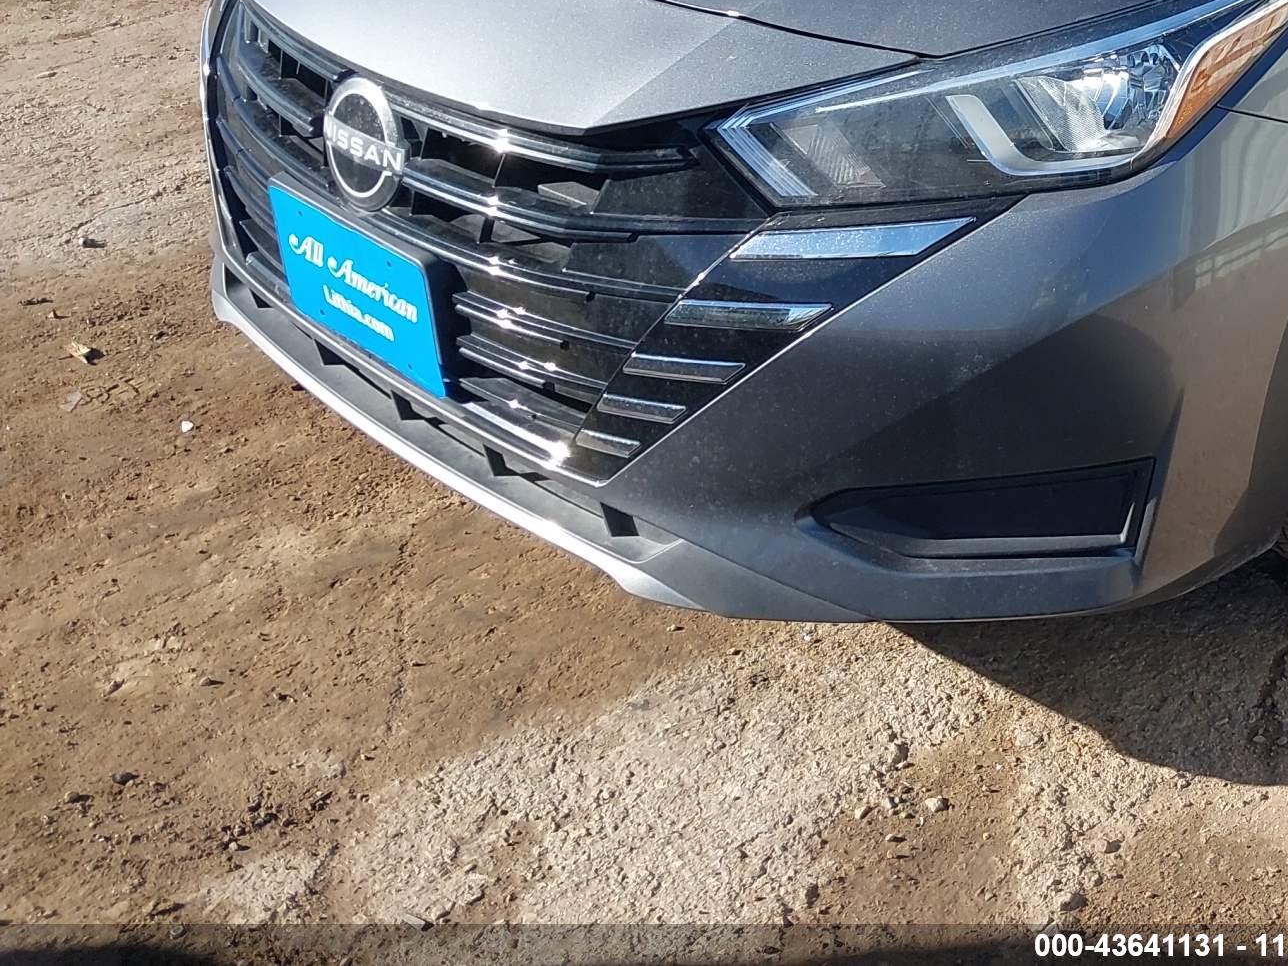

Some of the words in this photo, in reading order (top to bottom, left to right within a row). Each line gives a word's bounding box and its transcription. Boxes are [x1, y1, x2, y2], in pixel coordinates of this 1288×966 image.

[322, 113, 403, 172] NISSAN
[288, 233, 325, 268] All
[327, 256, 418, 323] American
[322, 284, 395, 341] Lithia.com
